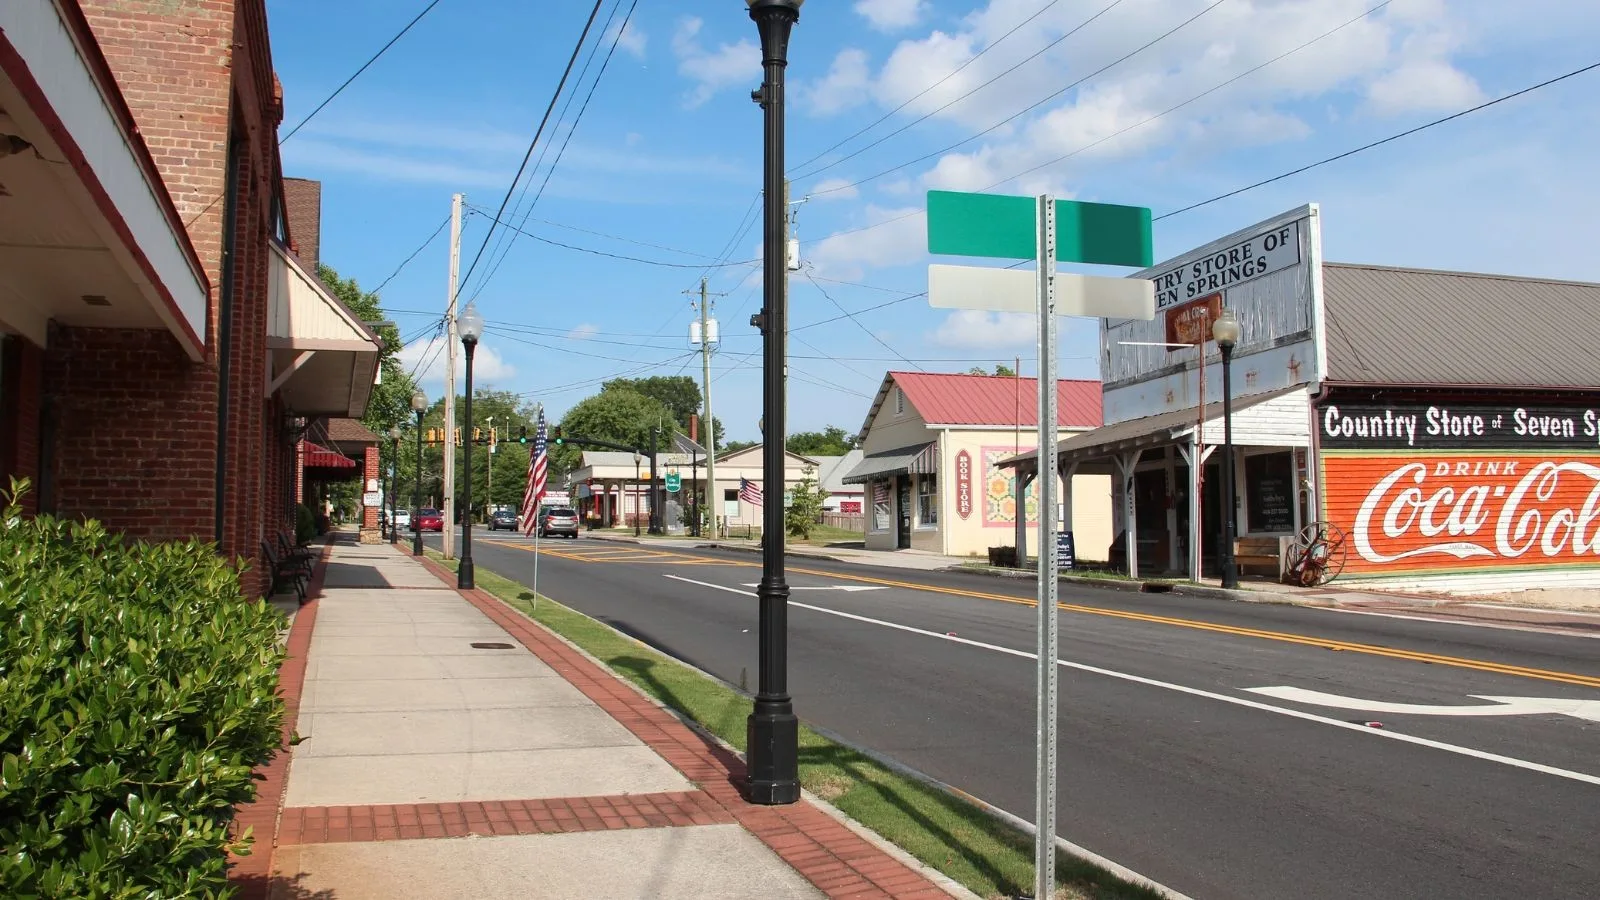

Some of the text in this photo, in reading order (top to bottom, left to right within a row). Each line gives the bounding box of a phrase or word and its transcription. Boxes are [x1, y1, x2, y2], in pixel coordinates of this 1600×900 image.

[1154, 228, 1290, 292] TRY STORE OF
[1154, 256, 1267, 308] EN SPRINGS
[1324, 406, 1416, 446] Country
[1426, 406, 1484, 436] Store
[1491, 415, 1503, 429] of
[1513, 407, 1575, 437] Seven
[959, 455, 970, 513] BOOK STORE
[1433, 461, 1519, 476] DRINK
[1353, 462, 1600, 563] Coca-Col
